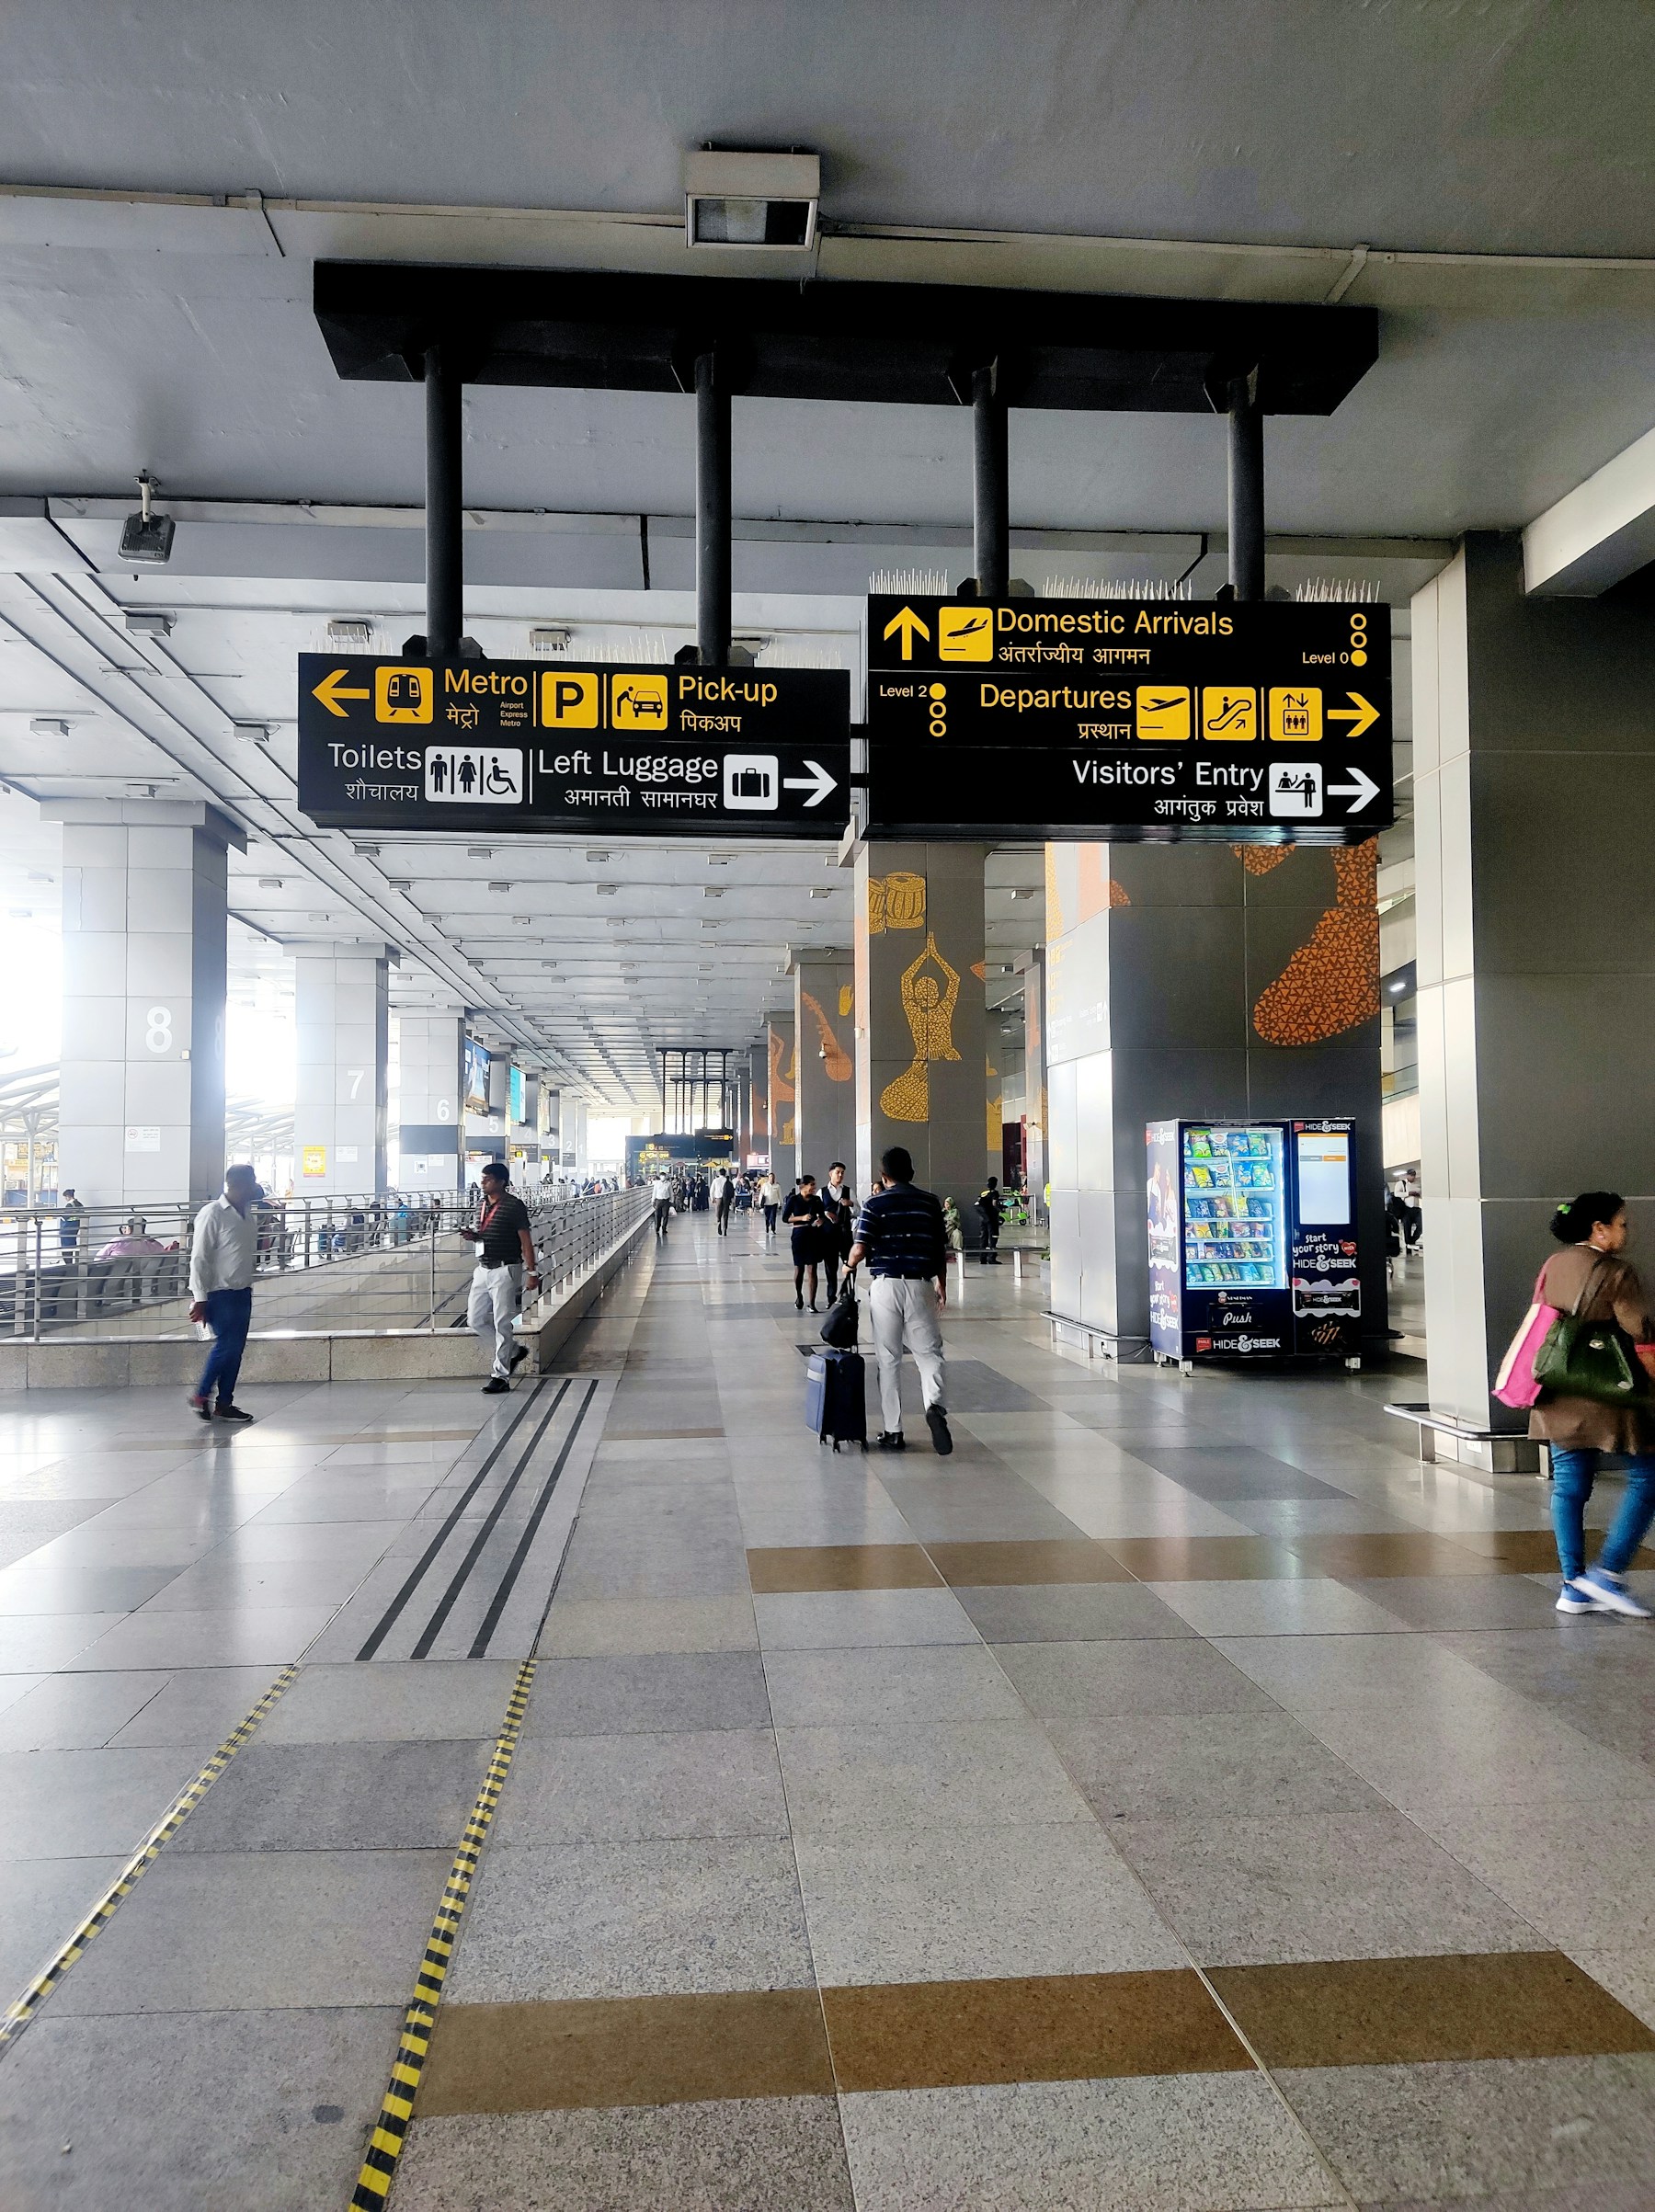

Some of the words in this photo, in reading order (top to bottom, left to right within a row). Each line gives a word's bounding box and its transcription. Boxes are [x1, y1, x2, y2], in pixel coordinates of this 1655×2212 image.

[999, 609, 1124, 633] Domestic
[1135, 610, 1233, 634] Arrivals
[1093, 649, 1150, 664] आगमन
[1303, 652, 1335, 664] Level
[1340, 652, 1349, 664] 0
[446, 669, 527, 695] Metro
[679, 676, 777, 707] Pick-up
[881, 685, 913, 697] Level
[919, 686, 927, 697] 2
[555, 680, 584, 719] P
[981, 684, 1131, 713] Departures
[446, 702, 479, 729] मेट्रो
[679, 710, 741, 732] पिकअप
[1078, 724, 1131, 739] प्रस्थान
[328, 743, 421, 770] Toilets
[540, 750, 592, 774] Left
[604, 751, 717, 782] Luggage
[1196, 762, 1263, 791] Entry
[345, 778, 418, 801] शौचालय
[565, 786, 630, 807] अमानती
[640, 792, 718, 808] सामानघर
[1155, 795, 1216, 821] आगंतुक
[1226, 795, 1264, 815] प्रवेश
[146, 1006, 172, 1054] 8
[348, 1069, 364, 1099] 7
[437, 1099, 450, 1121] 6
[489, 1115, 499, 1134] 5
[523, 1127, 532, 1142] 4
[548, 1134, 555, 1146] 3
[565, 1140, 573, 1151] 2
[1306, 1233, 1327, 1243] Start
[1293, 1244, 1315, 1257] your
[1315, 1243, 1340, 1254] story
[1223, 1311, 1251, 1326] Push
